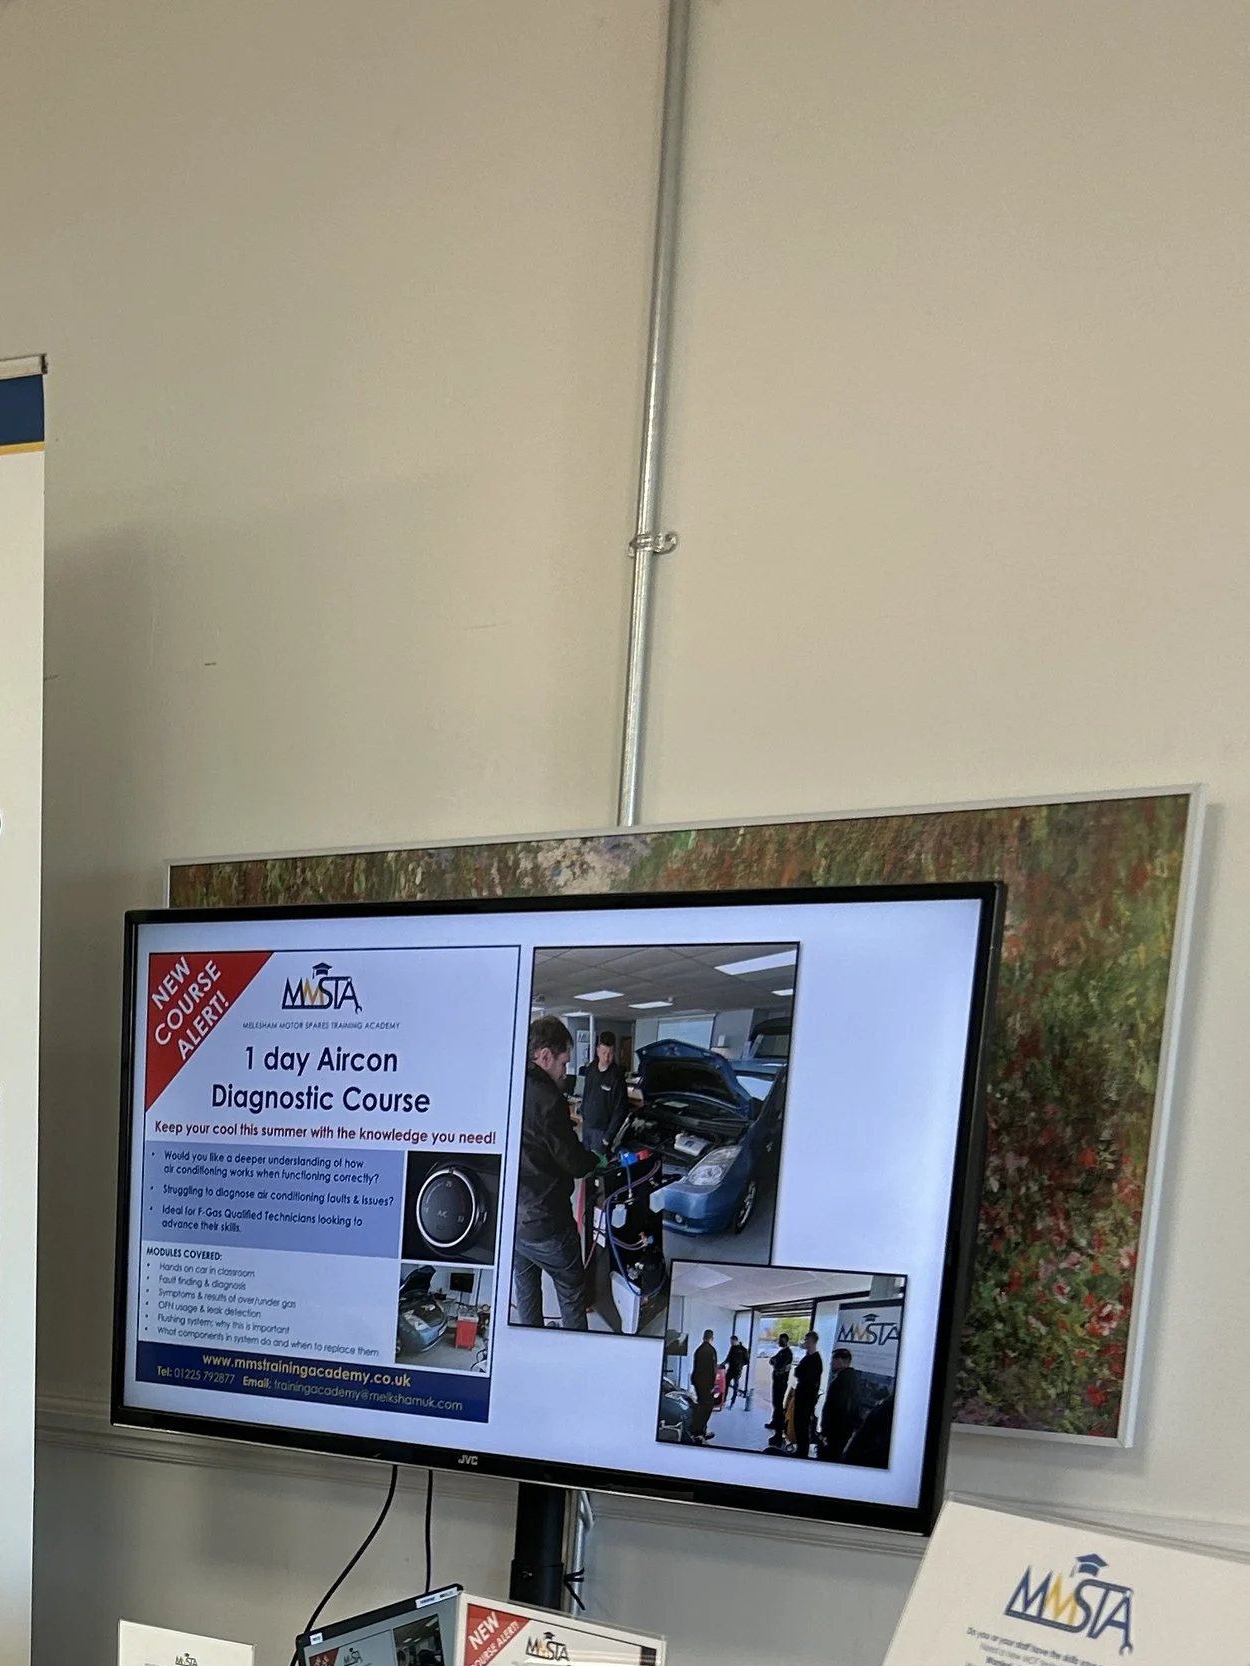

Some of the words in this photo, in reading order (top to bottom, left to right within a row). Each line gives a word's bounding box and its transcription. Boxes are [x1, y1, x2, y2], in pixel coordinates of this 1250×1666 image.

[151, 956, 190, 1010] NEW
[282, 976, 362, 1014] MMSTA
[154, 960, 222, 1046] COURSE
[177, 991, 230, 1060] ALERT!
[245, 1046, 253, 1069] 1
[263, 1045, 310, 1076] day
[316, 1046, 397, 1071] Aircon
[212, 1083, 333, 1114] Diagnostic
[342, 1086, 430, 1112] Course
[155, 1120, 182, 1135] Keep
[185, 1124, 210, 1136] your
[212, 1122, 237, 1135] cool
[239, 1122, 258, 1135] this
[261, 1126, 307, 1137] summer
[310, 1125, 333, 1138] with
[337, 1126, 356, 1139] the
[359, 1126, 428, 1144] knowledge
[431, 1132, 455, 1144] you
[458, 1131, 496, 1144] need!
[163, 1163, 174, 1173] air
[175, 1164, 227, 1178] conditioning
[229, 1167, 253, 1177] works
[255, 1167, 279, 1178] when
[281, 1168, 331, 1183] functioning
[333, 1172, 379, 1185] correctly?
[164, 1150, 189, 1160] Would
[192, 1153, 207, 1163] you
[209, 1152, 224, 1162] like
[226, 1154, 232, 1162] a
[234, 1152, 265, 1165] deeper
[267, 1155, 331, 1169] understanding
[333, 1157, 342, 1167] of
[344, 1158, 364, 1168] how
[162, 1183, 203, 1197] Struggling
[205, 1186, 213, 1196] to
[215, 1187, 254, 1199] diagnose
[256, 1189, 268, 1199] air
[269, 1191, 325, 1204] conditioning
[326, 1192, 350, 1204] faults
[352, 1194, 359, 1204] &
[361, 1194, 394, 1206] issues?
[161, 1218, 198, 1229] advance
[200, 1220, 218, 1230] their
[220, 1221, 240, 1232] skills.
[162, 1204, 183, 1214] Ideal
[184, 1205, 196, 1215] for
[197, 1206, 222, 1217] F-Gas
[223, 1208, 262, 1220] Qualified
[264, 1210, 315, 1223] Technicians
[317, 1213, 351, 1228] looking
[353, 1215, 362, 1226] to
[146, 1246, 181, 1257] MODULES
[157, 1365, 172, 1376] Tel:
[174, 1367, 200, 1380] 01225
[202, 1370, 235, 1384] 792877
[202, 1354, 410, 1386] www.mmstrainingacademy.co.uk
[242, 1375, 271, 1389] Email:
[274, 1379, 462, 1410] trainingacademy@melkshamuk.com
[458, 1455, 478, 1465] JVC
[1004, 1566, 1133, 1656] MMSTA
[468, 1612, 500, 1650] NEW
[497, 1620, 520, 1649] ALERT!
